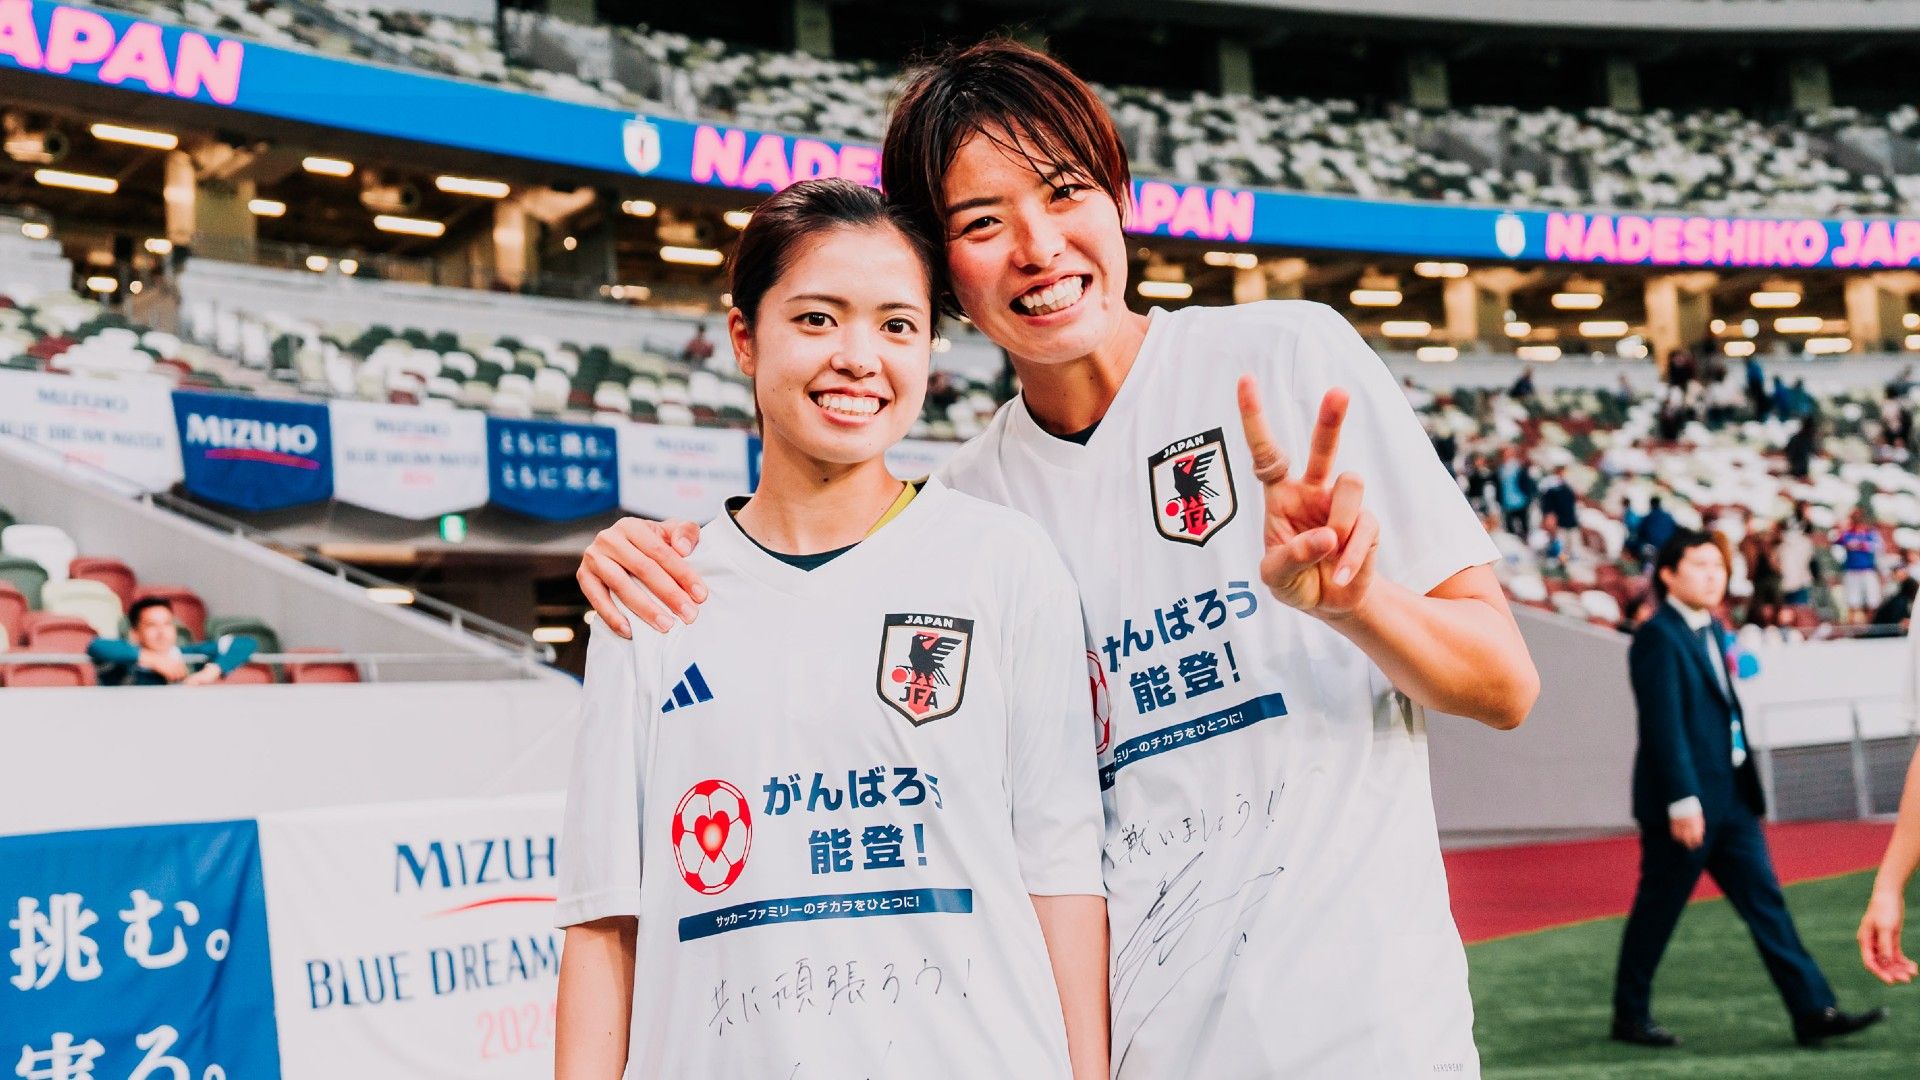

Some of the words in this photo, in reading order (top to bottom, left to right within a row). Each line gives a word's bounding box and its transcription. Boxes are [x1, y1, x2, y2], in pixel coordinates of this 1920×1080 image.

[692, 125, 884, 192] NADE
[1127, 181, 1255, 243] PAN
[1545, 212, 1828, 267] NADESHIKO
[186, 413, 318, 455] MIZUHO
[1163, 434, 1204, 459] JAPAN
[1179, 506, 1216, 532] JFA
[905, 615, 953, 628] JAPAN
[898, 686, 939, 709] JFA
[1129, 641, 1240, 715] 能登!
[808, 823, 928, 875] 能登!
[8, 890, 231, 991] 挑む。
[305, 951, 416, 1011] BLUE
[430, 935, 559, 996] DREAM
